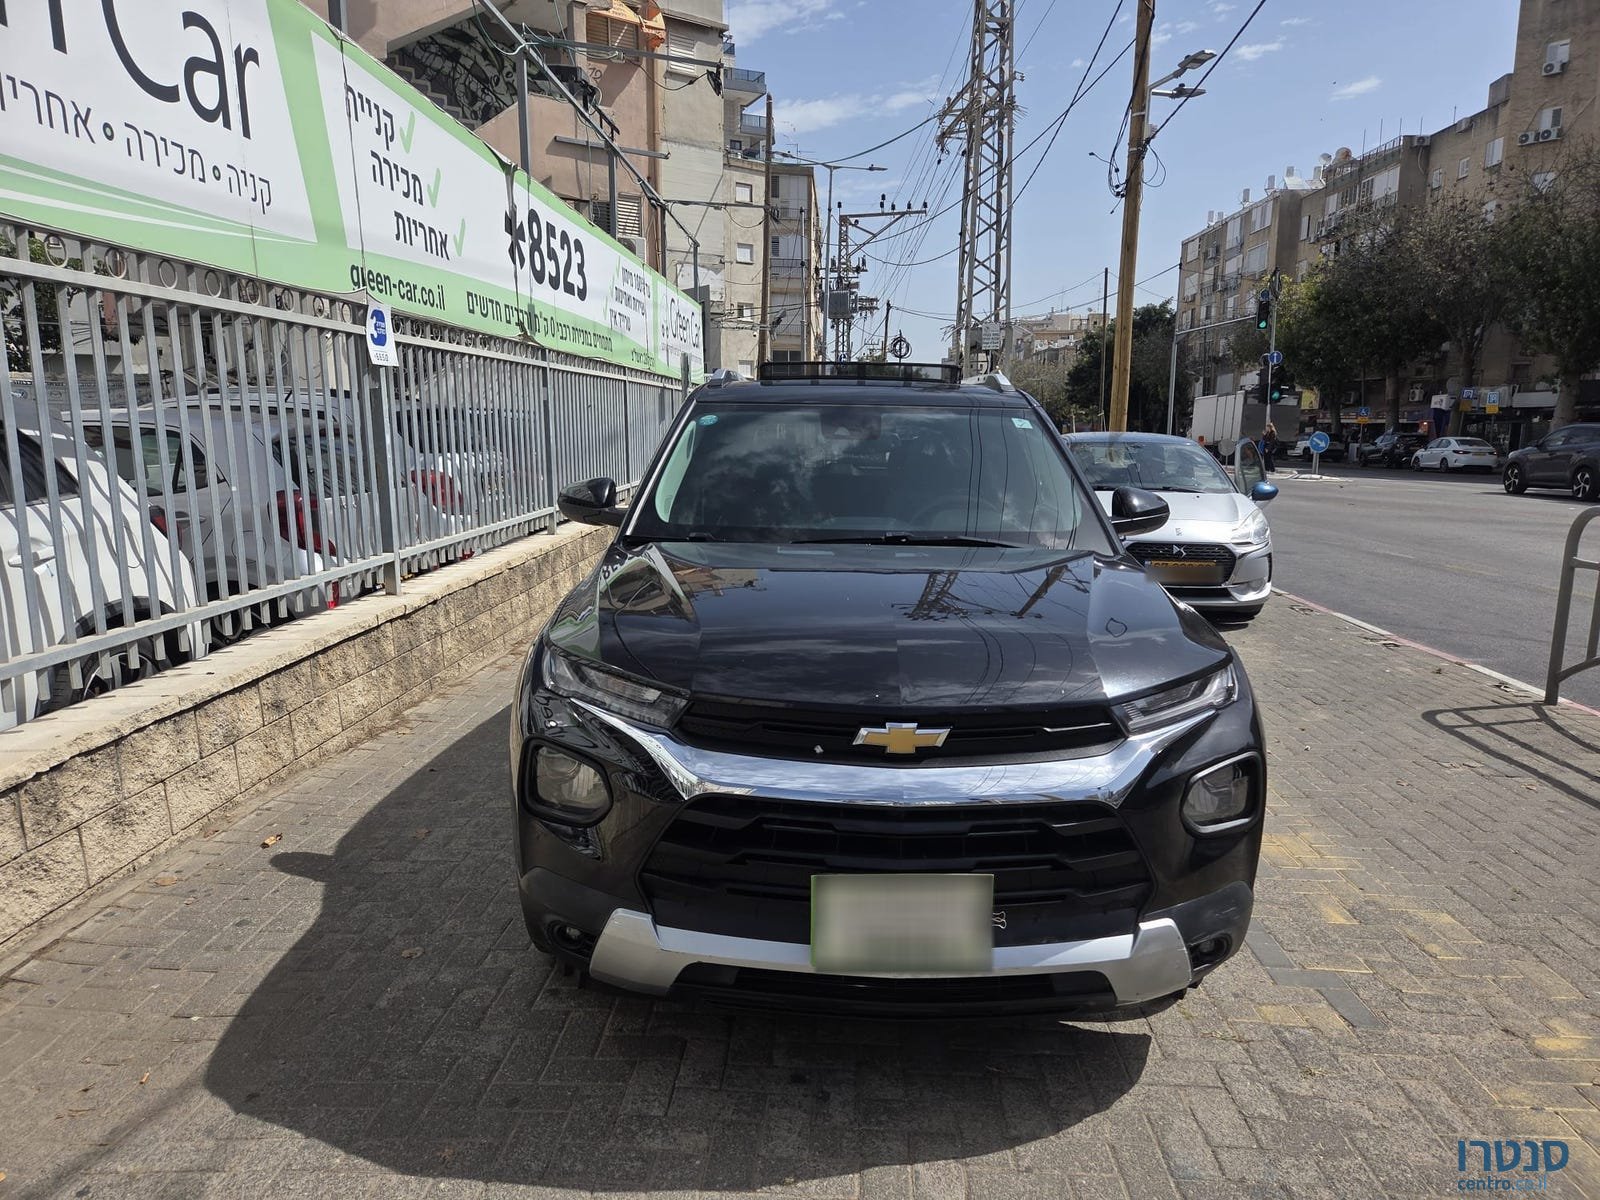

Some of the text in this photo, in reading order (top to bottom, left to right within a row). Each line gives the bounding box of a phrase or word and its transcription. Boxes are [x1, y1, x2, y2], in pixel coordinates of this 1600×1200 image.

[102, 0, 260, 140] Car
[124, 121, 207, 184] מכירה
[371, 150, 424, 206] מכירה
[226, 163, 272, 215] קניה
[394, 210, 450, 261] אחריות
[467, 291, 503, 323] חדשים
